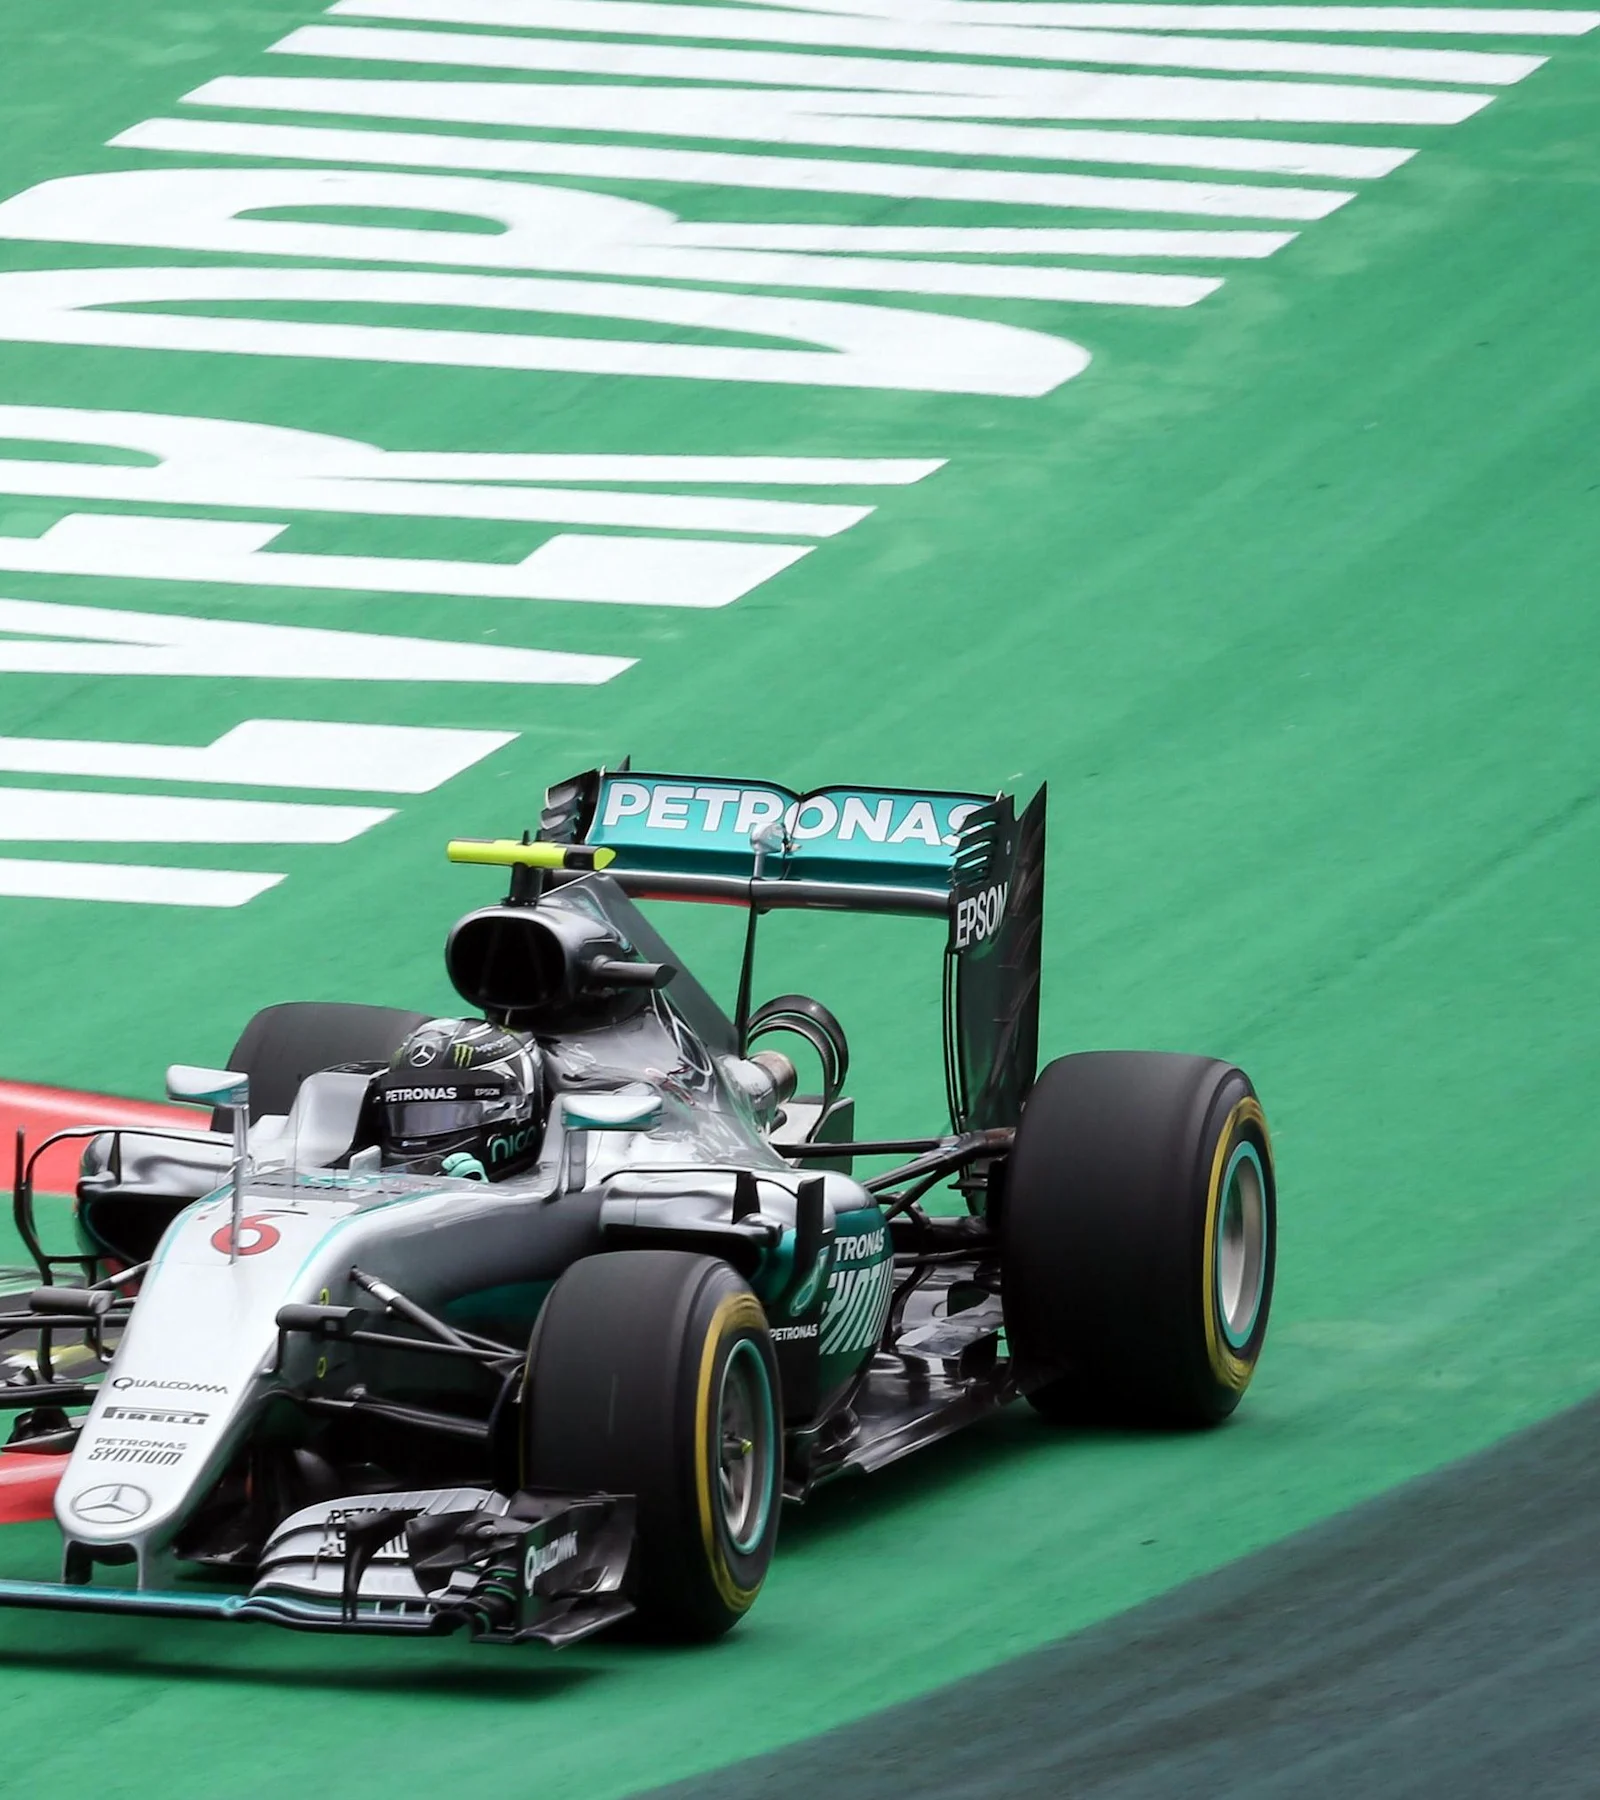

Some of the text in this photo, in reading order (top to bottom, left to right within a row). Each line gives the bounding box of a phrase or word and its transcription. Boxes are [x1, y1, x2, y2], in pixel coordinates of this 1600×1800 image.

[602, 782, 984, 848] PETRONAS
[955, 881, 1008, 949] EPSON
[385, 1087, 500, 1103] PETRONAS EPSON
[211, 1214, 282, 1256] 6
[834, 1228, 885, 1262] TRONAS
[769, 1323, 818, 1341] PETRONAS
[112, 1377, 229, 1395] QUALCOMM
[101, 1406, 210, 1426] PIRELLI
[94, 1437, 189, 1450] PETRONAS
[88, 1447, 183, 1466] SYNTIUM
